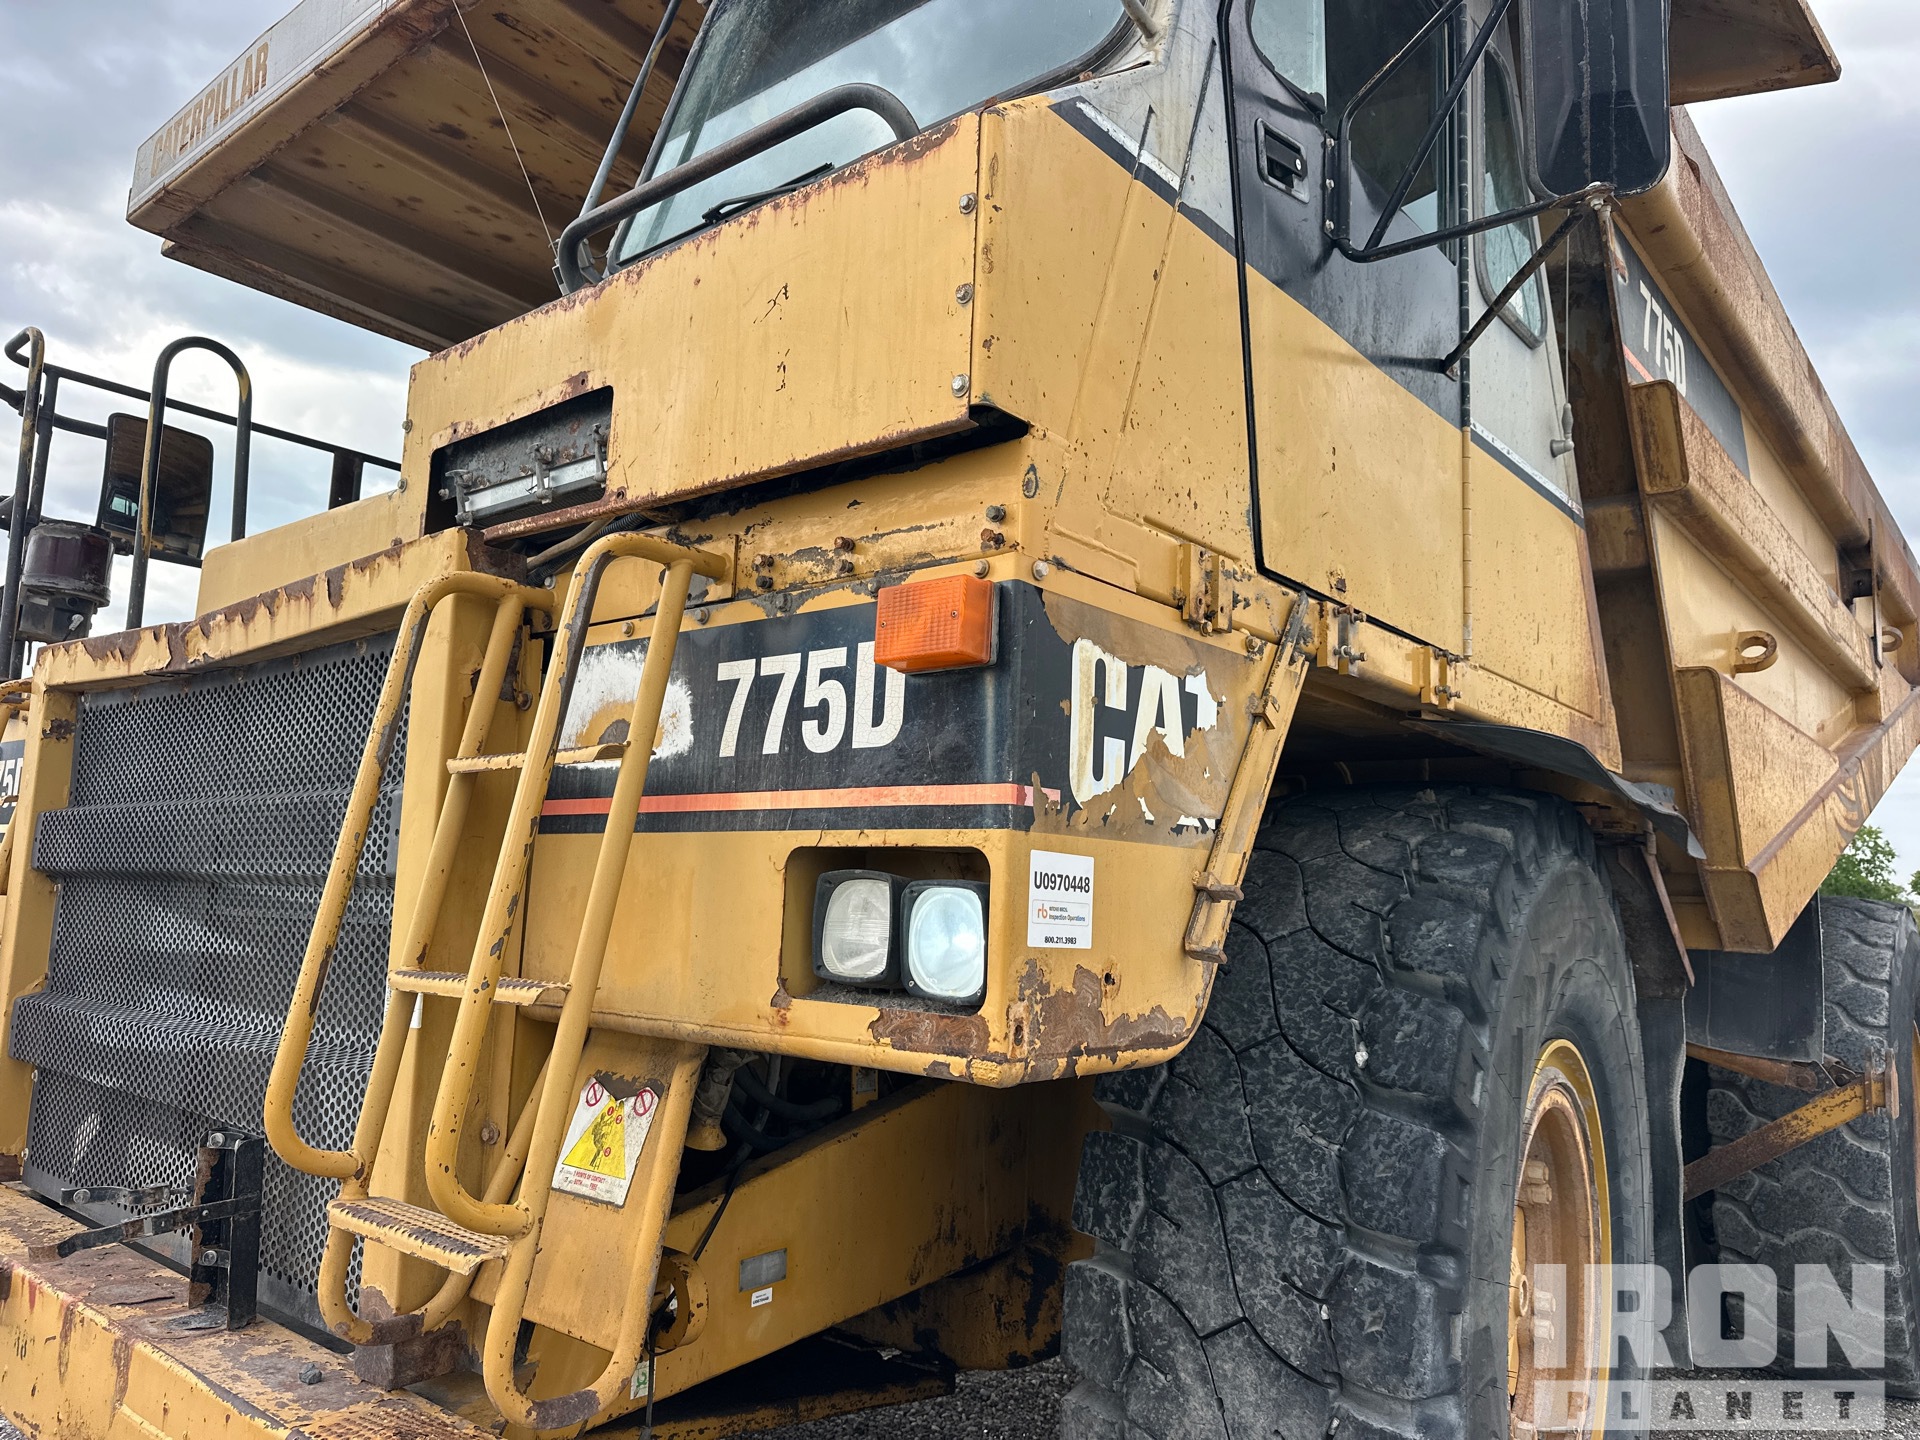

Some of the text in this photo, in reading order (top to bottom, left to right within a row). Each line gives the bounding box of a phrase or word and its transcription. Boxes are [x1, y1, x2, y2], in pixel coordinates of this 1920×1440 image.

[151, 41, 269, 178] CATERPILLAR
[1640, 279, 1687, 398] 775D
[717, 641, 906, 758] 775D
[1034, 871, 1090, 893] U0970448
[1044, 936, 1077, 945] 800.211.3983
[1049, 913, 1067, 921] Inspection
